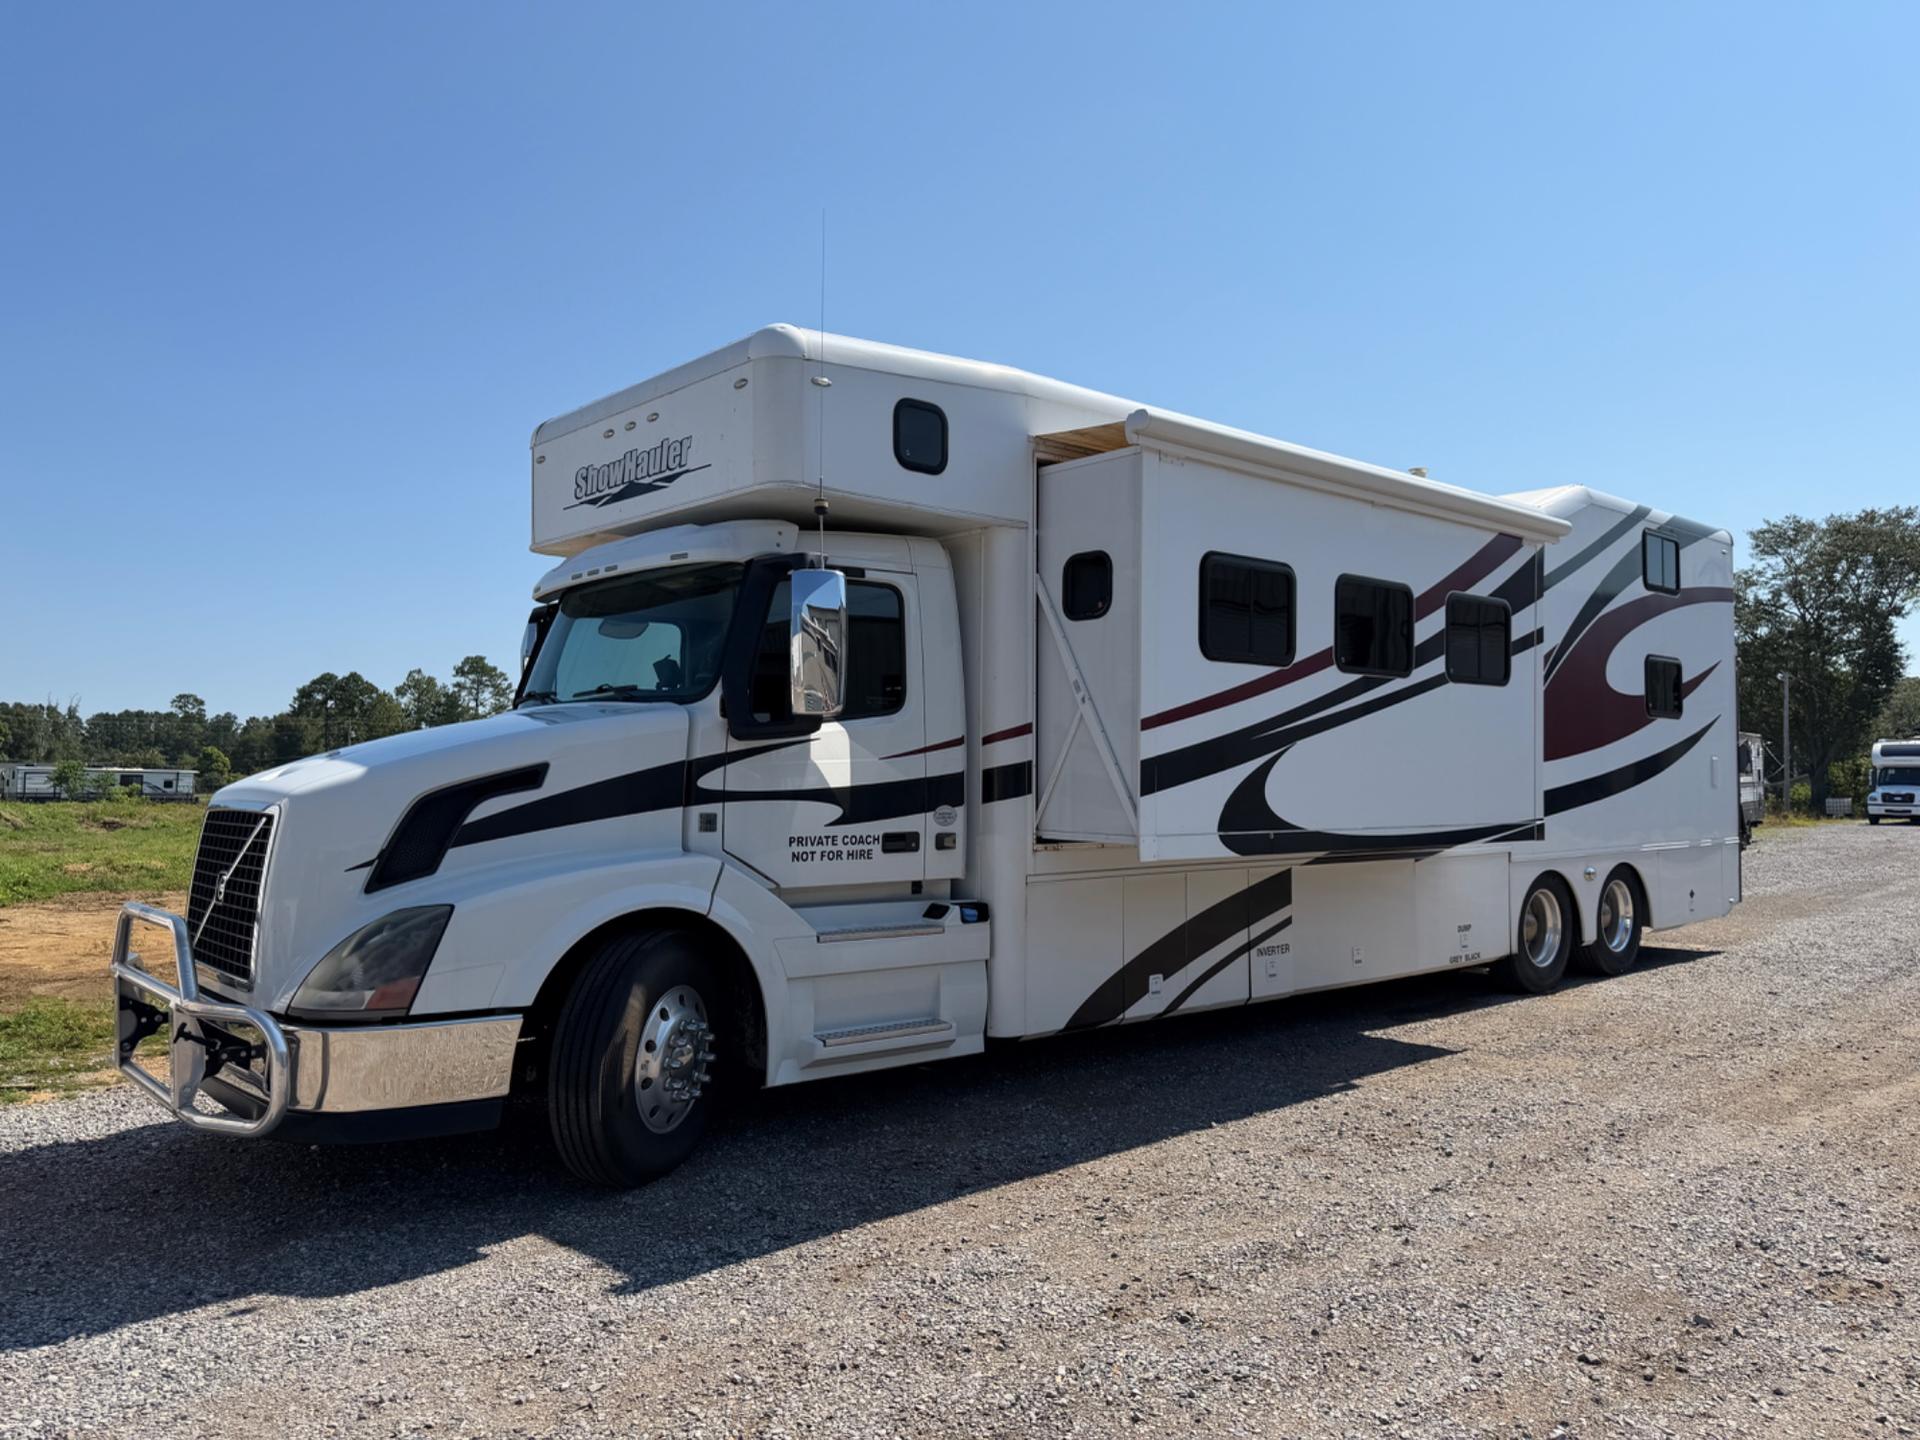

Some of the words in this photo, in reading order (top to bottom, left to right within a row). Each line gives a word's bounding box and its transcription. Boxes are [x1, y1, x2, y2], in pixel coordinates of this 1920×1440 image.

[574, 435, 693, 500] ShowHauler
[788, 834, 839, 848] PRIVATE
[841, 834, 880, 846] COACH
[791, 850, 817, 863] NOT
[820, 849, 843, 861] FOR
[846, 848, 873, 860] HIRE
[1256, 943, 1290, 957] INVERTER
